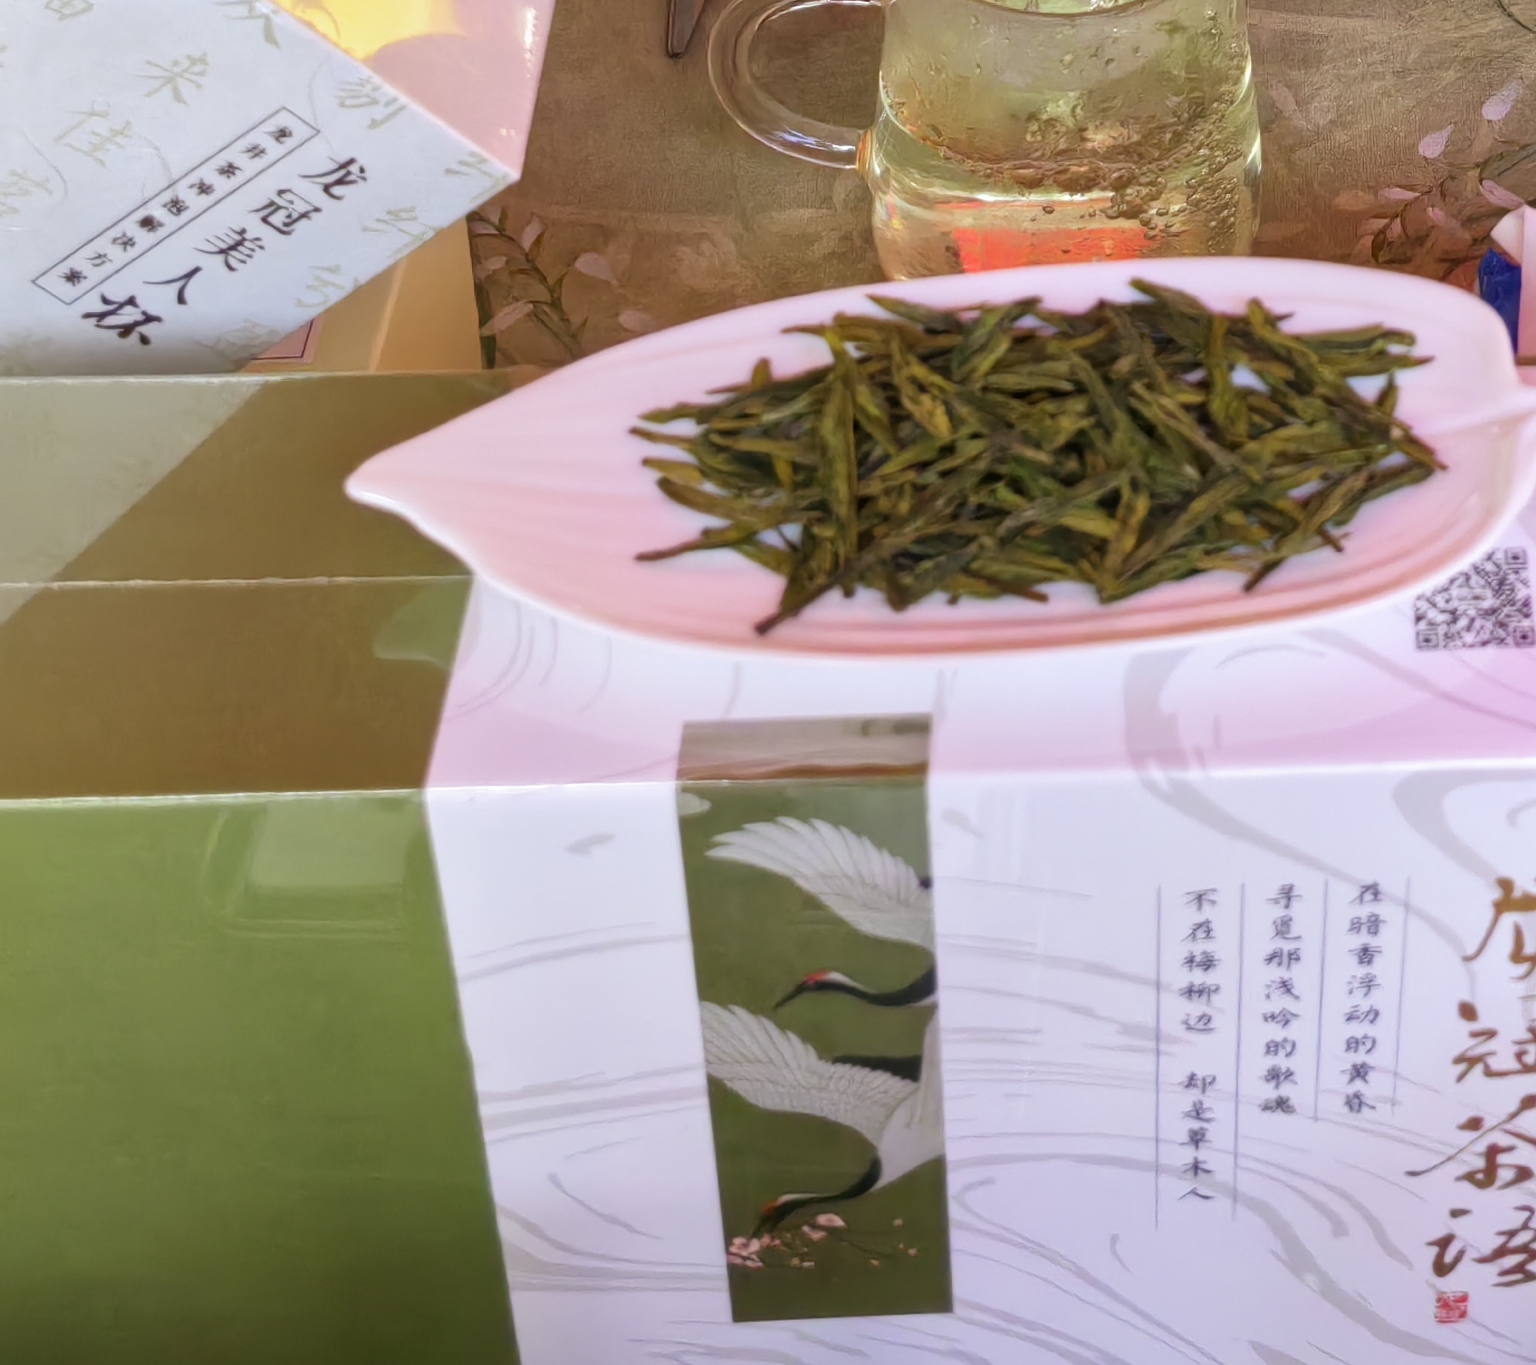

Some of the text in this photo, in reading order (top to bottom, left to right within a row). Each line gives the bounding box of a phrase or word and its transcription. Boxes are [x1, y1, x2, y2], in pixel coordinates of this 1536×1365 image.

[57, 123, 295, 289] 龙井茶冲泡解决方案
[81, 156, 370, 346] 龙冠美人杯
[1178, 887, 1222, 1201] 不在梅柳边 却是草木人
[1341, 881, 1386, 1114] 在暗香浮动的黄昏
